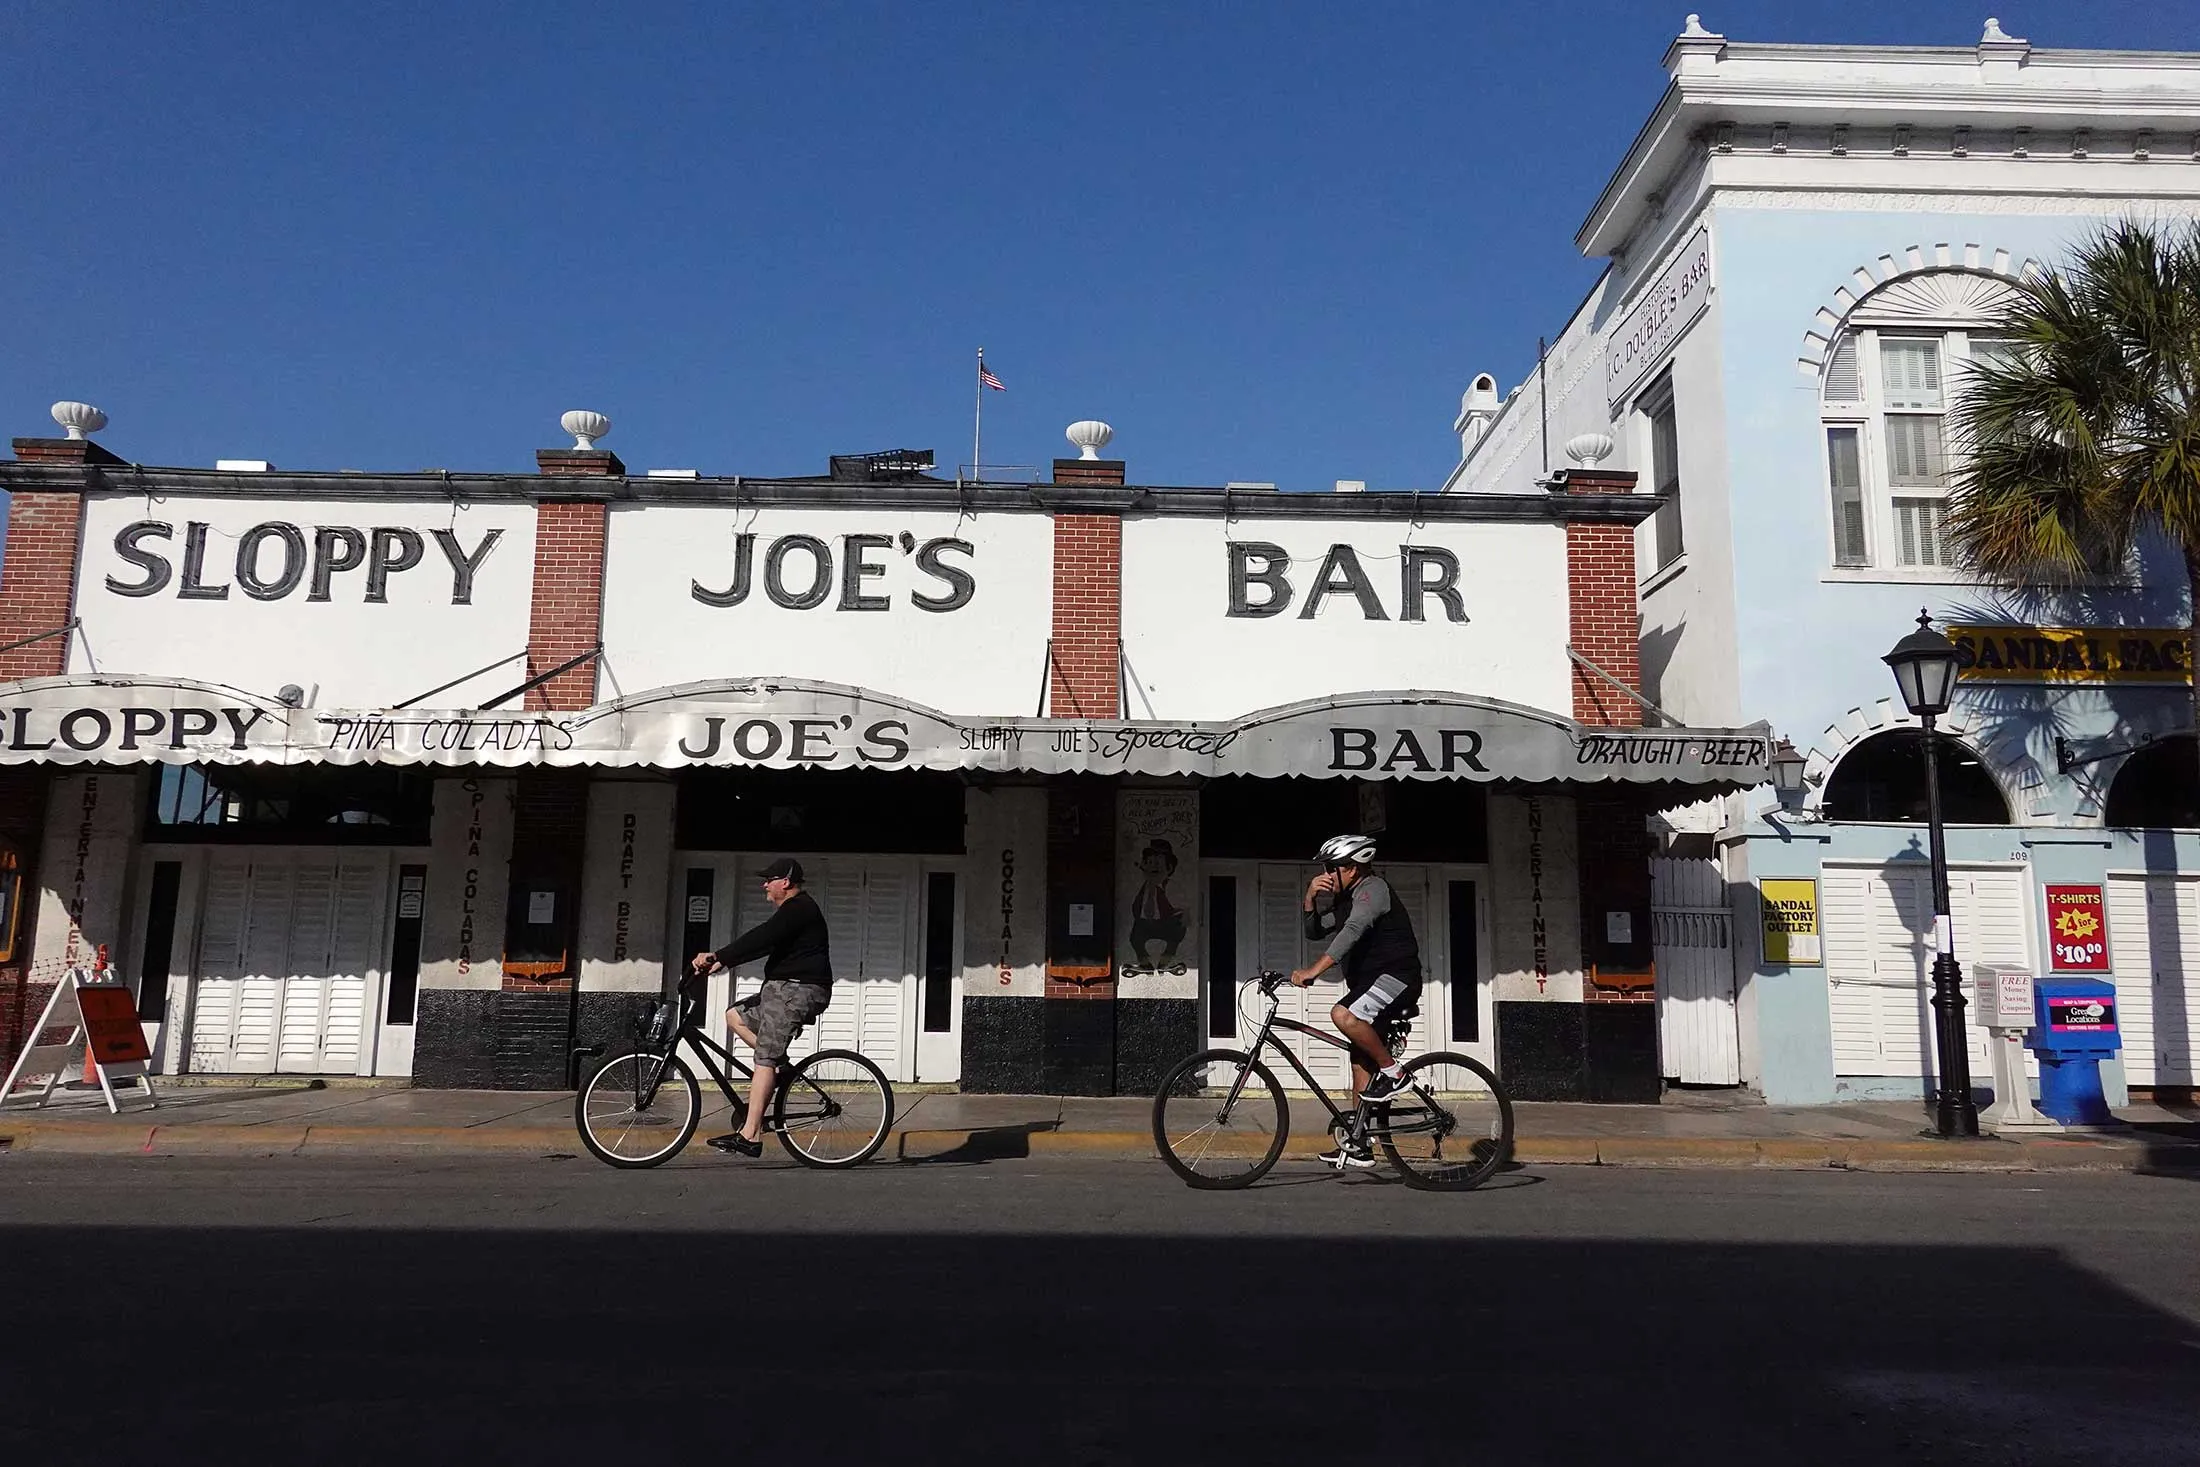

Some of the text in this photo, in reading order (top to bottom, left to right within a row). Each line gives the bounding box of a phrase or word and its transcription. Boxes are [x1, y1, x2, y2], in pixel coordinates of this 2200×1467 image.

[1626, 289, 1677, 364] DOUBLE'S
[1681, 251, 1708, 300] BAR
[1640, 276, 1671, 320] HISTORIC
[105, 520, 505, 605] SLOPPY
[691, 529, 975, 613] JOE'S
[1225, 541, 1471, 623] BAR
[1955, 635, 2105, 670] SANDAL
[0, 707, 267, 751] LOPPY
[329, 713, 574, 751] PIÑA COLADAS
[678, 715, 909, 763] JOE'S
[959, 727, 1024, 752] SLOPPY
[1051, 727, 1099, 753] JOE'S
[1327, 727, 1490, 773] BAR
[1576, 737, 1764, 766] DRAUGHT BEER
[2010, 851, 2028, 861] 209
[457, 793, 485, 975] PIÑA COLADAS
[613, 813, 636, 962] DRAFT BEER
[1528, 799, 1548, 994] ENTERTAINMENT
[2049, 894, 2101, 904] T-SHIRTS
[999, 849, 1015, 986] COCKTAILS
[1763, 911, 1815, 921] FACTORY
[1764, 900, 1813, 910] SANDAL
[2066, 915, 2092, 931] 4 for
[1767, 922, 1813, 932] OUTLET
[2055, 943, 2102, 964] $10.00
[2001, 976, 2030, 985] FREE
[2001, 1005, 2031, 1013] Coupons
[2065, 1015, 2101, 1023] Locations
